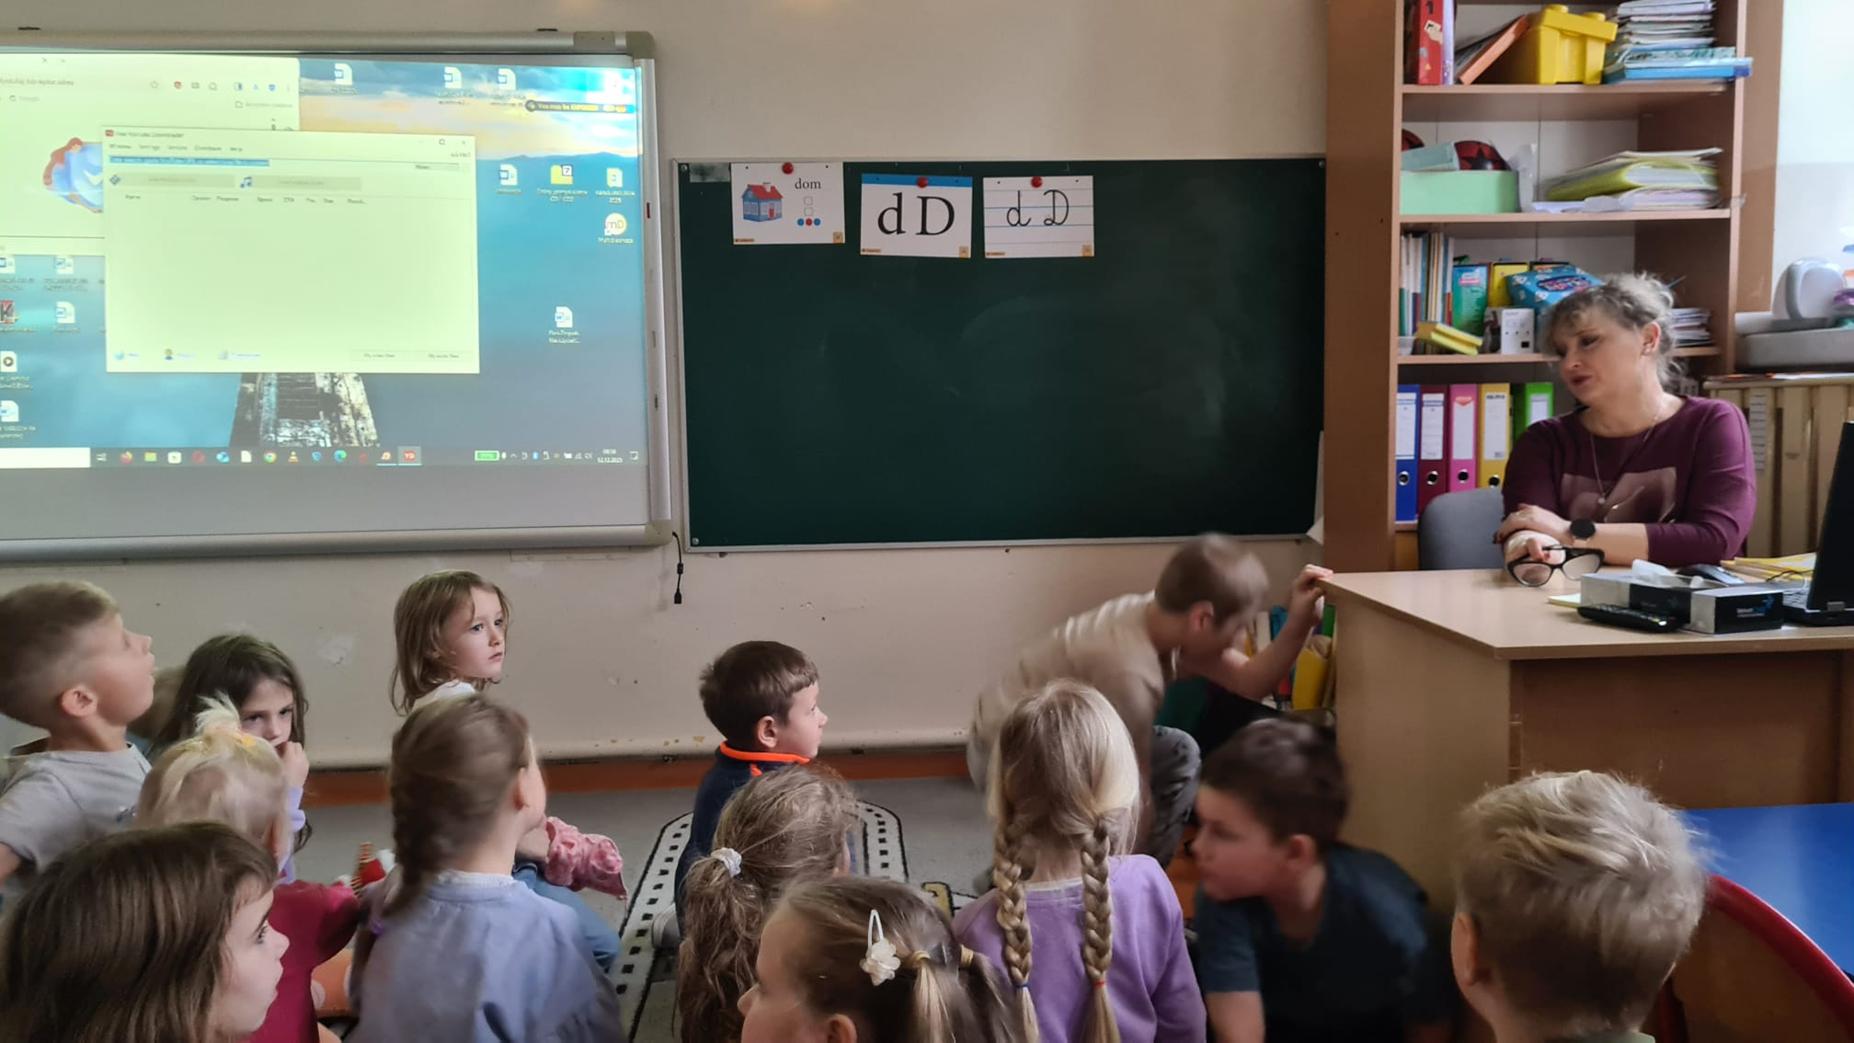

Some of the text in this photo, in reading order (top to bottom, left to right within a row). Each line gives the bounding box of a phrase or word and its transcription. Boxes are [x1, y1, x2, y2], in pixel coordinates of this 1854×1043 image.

[795, 178, 821, 190] dom
[877, 192, 955, 236] d D
[1007, 189, 1069, 227] d D
